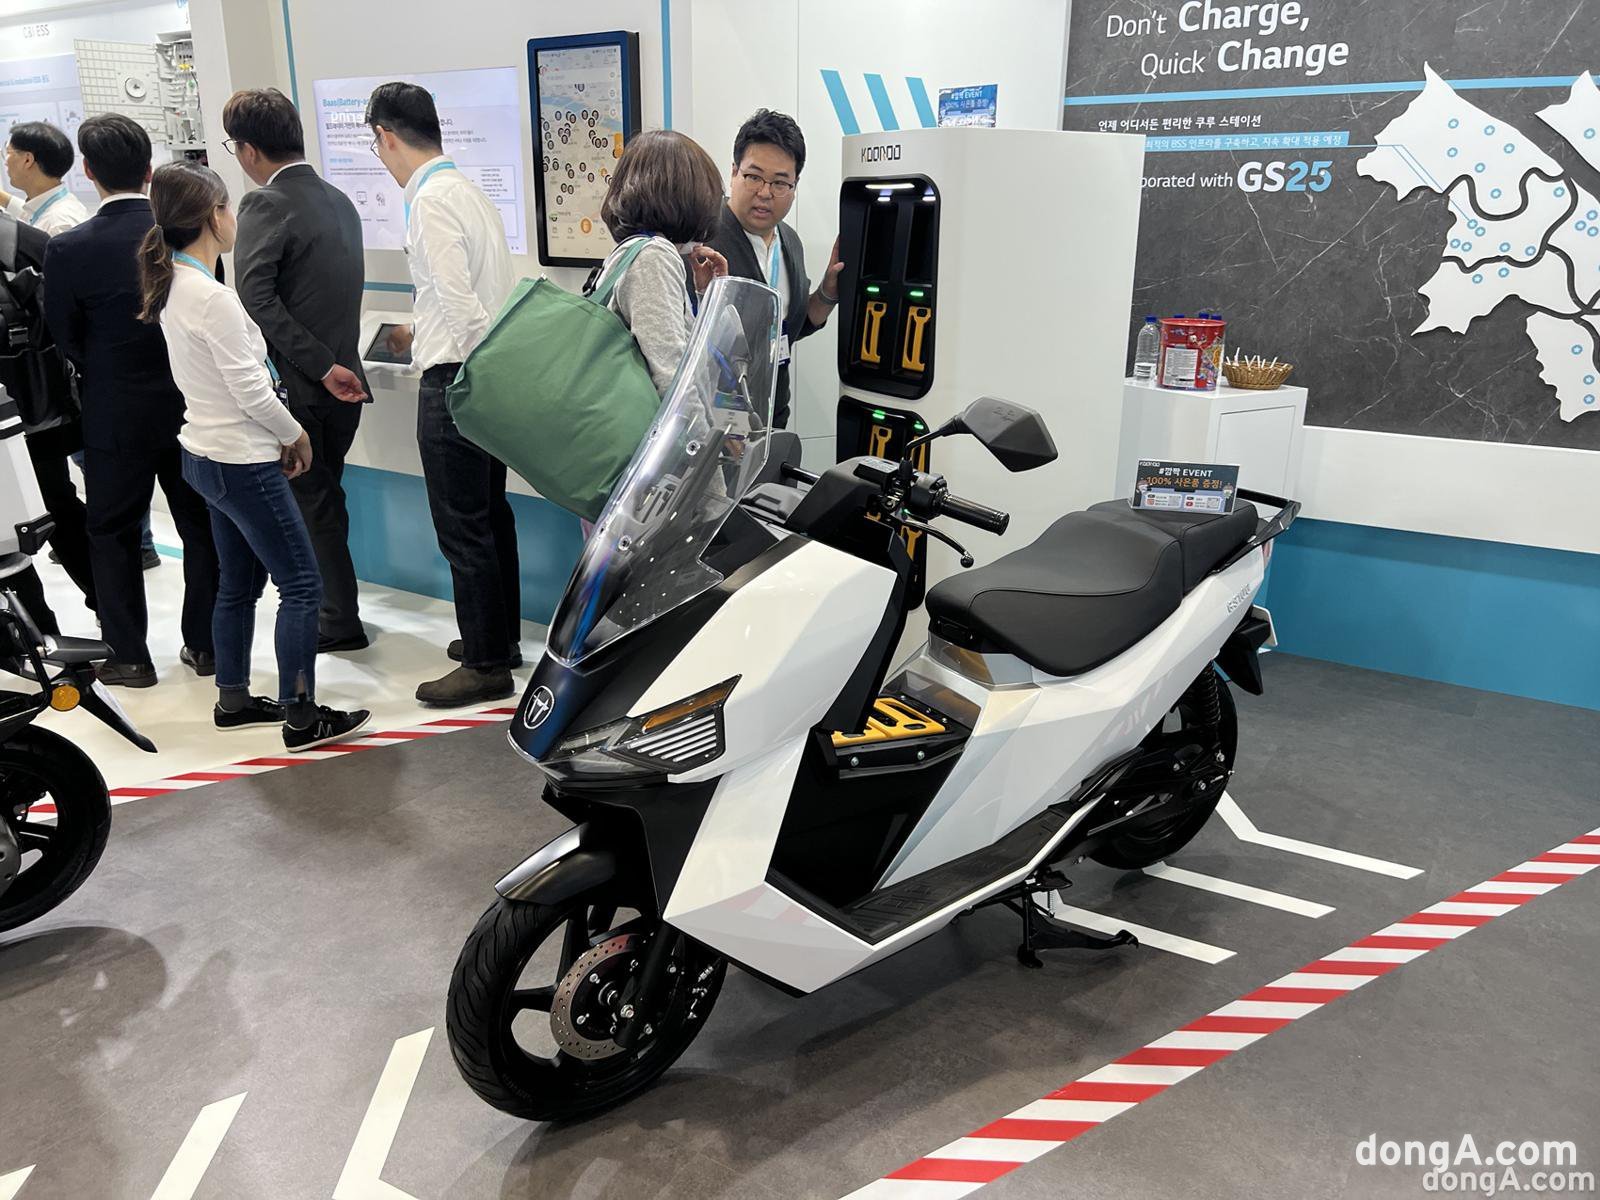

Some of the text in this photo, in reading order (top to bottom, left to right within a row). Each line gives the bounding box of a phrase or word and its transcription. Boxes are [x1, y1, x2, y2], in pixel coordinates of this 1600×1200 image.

[1107, 0, 1311, 38] Don't Charge,
[1140, 39, 1350, 78] Quick Change
[964, 90, 983, 99] EVENT
[1098, 115, 1262, 132] 언제 어디서든 편리한 쿠루 스테이션
[1171, 139, 1187, 149] BSS
[1189, 138, 1221, 149] 인프라를
[1263, 137, 1280, 147] 지속
[1282, 136, 1300, 146] 확대
[1303, 135, 1320, 146] 적용
[1323, 135, 1342, 146] 예정
[1200, 172, 1233, 188] with
[1237, 160, 1333, 193] GS25
[1146, 476, 1172, 485] 100%
[1182, 468, 1213, 478] EVENT
